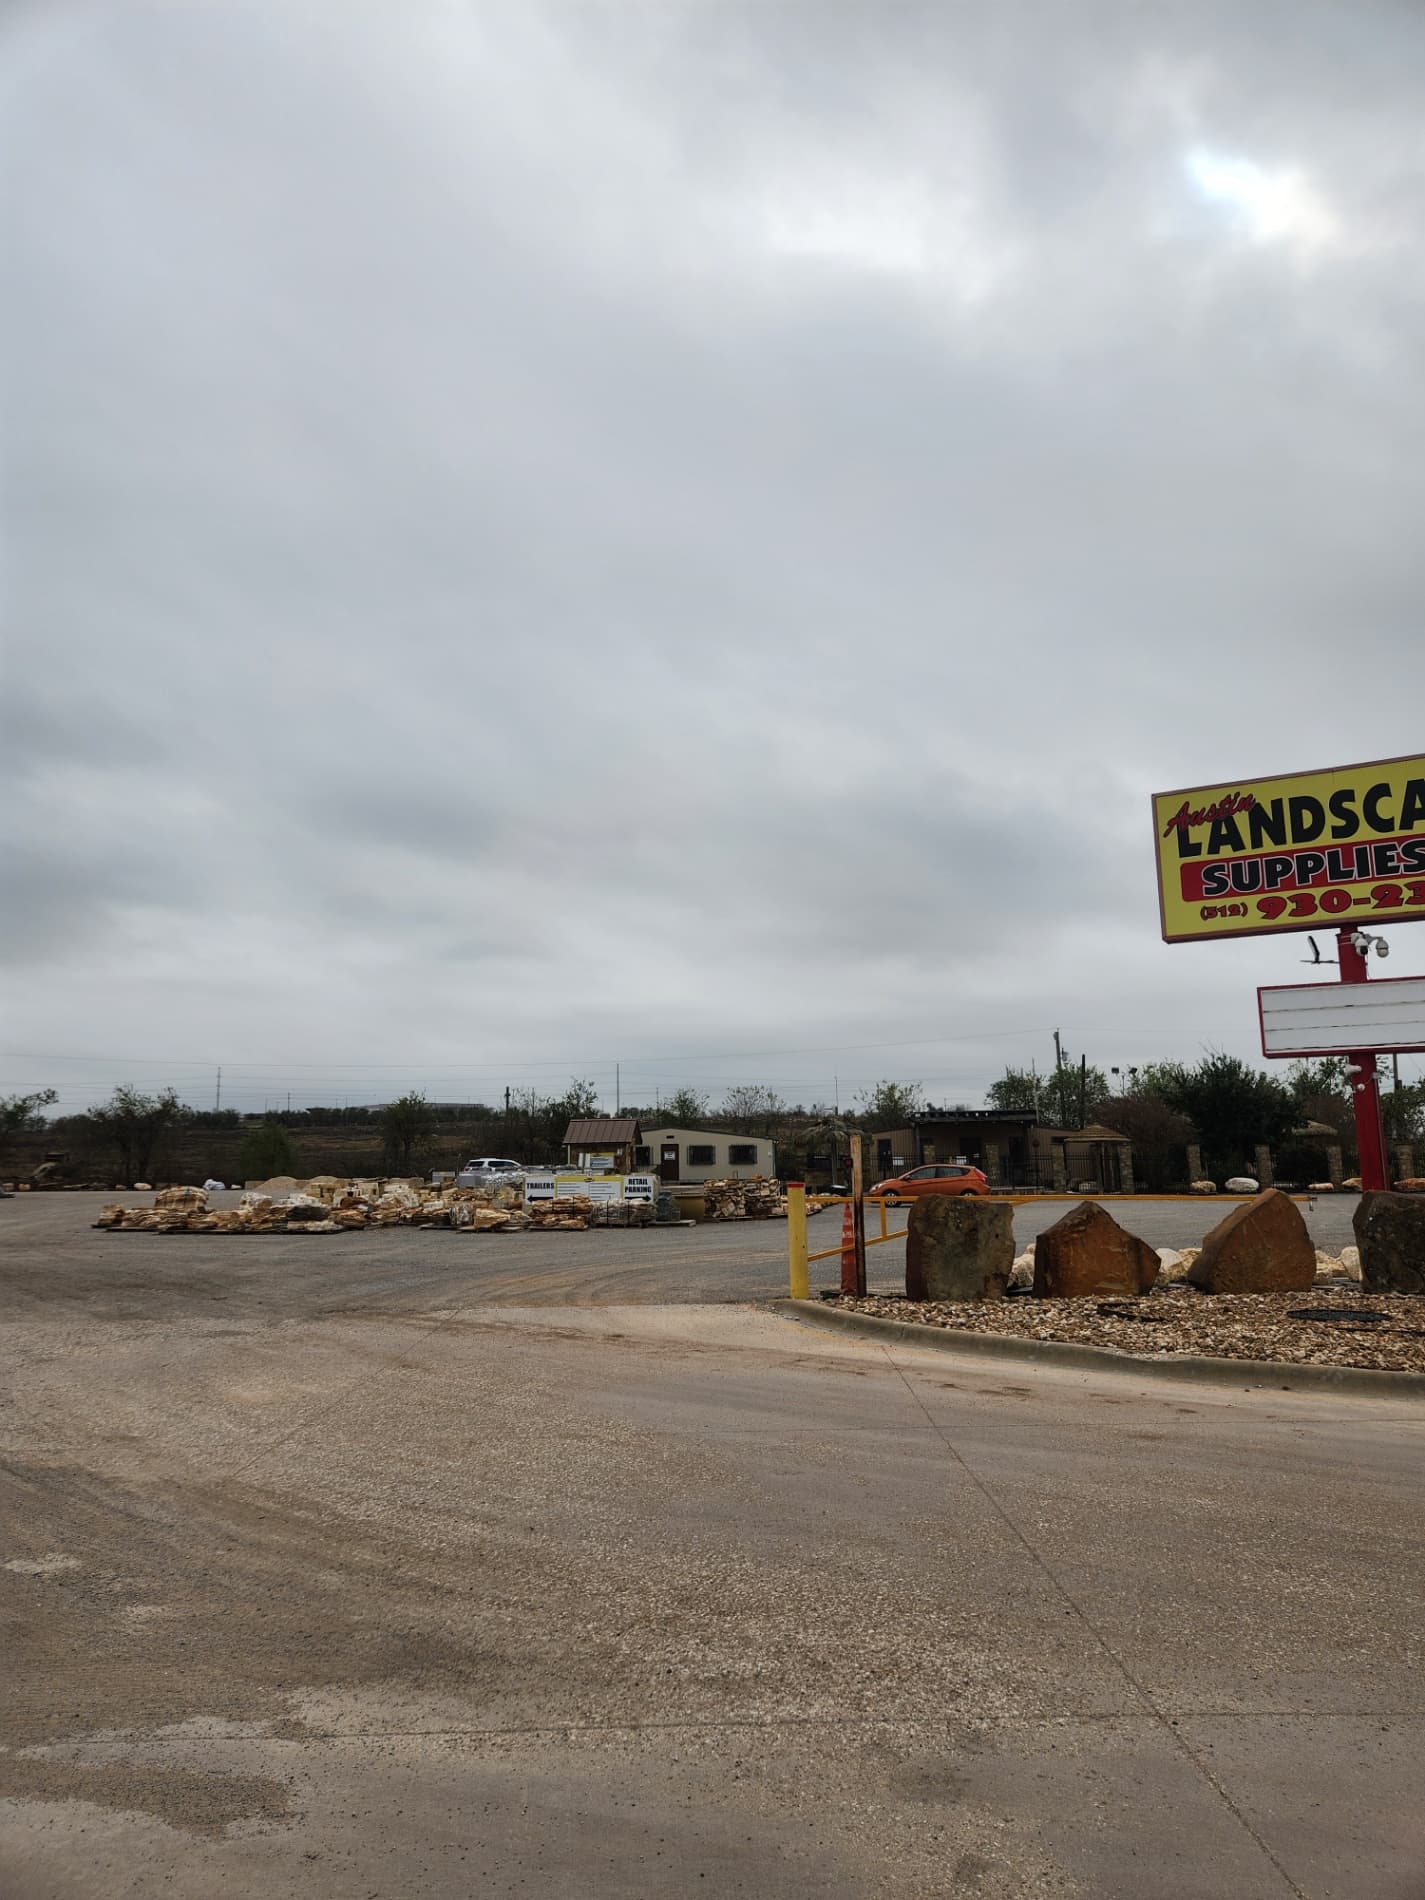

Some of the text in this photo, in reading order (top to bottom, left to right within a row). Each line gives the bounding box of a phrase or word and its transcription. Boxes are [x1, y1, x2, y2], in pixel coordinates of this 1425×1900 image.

[1163, 792, 1256, 838] Austin
[1176, 778, 1425, 858] LANDSCA
[1201, 837, 1425, 897] SUPPLIES
[1200, 880, 1425, 921] (512) 930-23
[624, 1185, 652, 1193] PARKING
